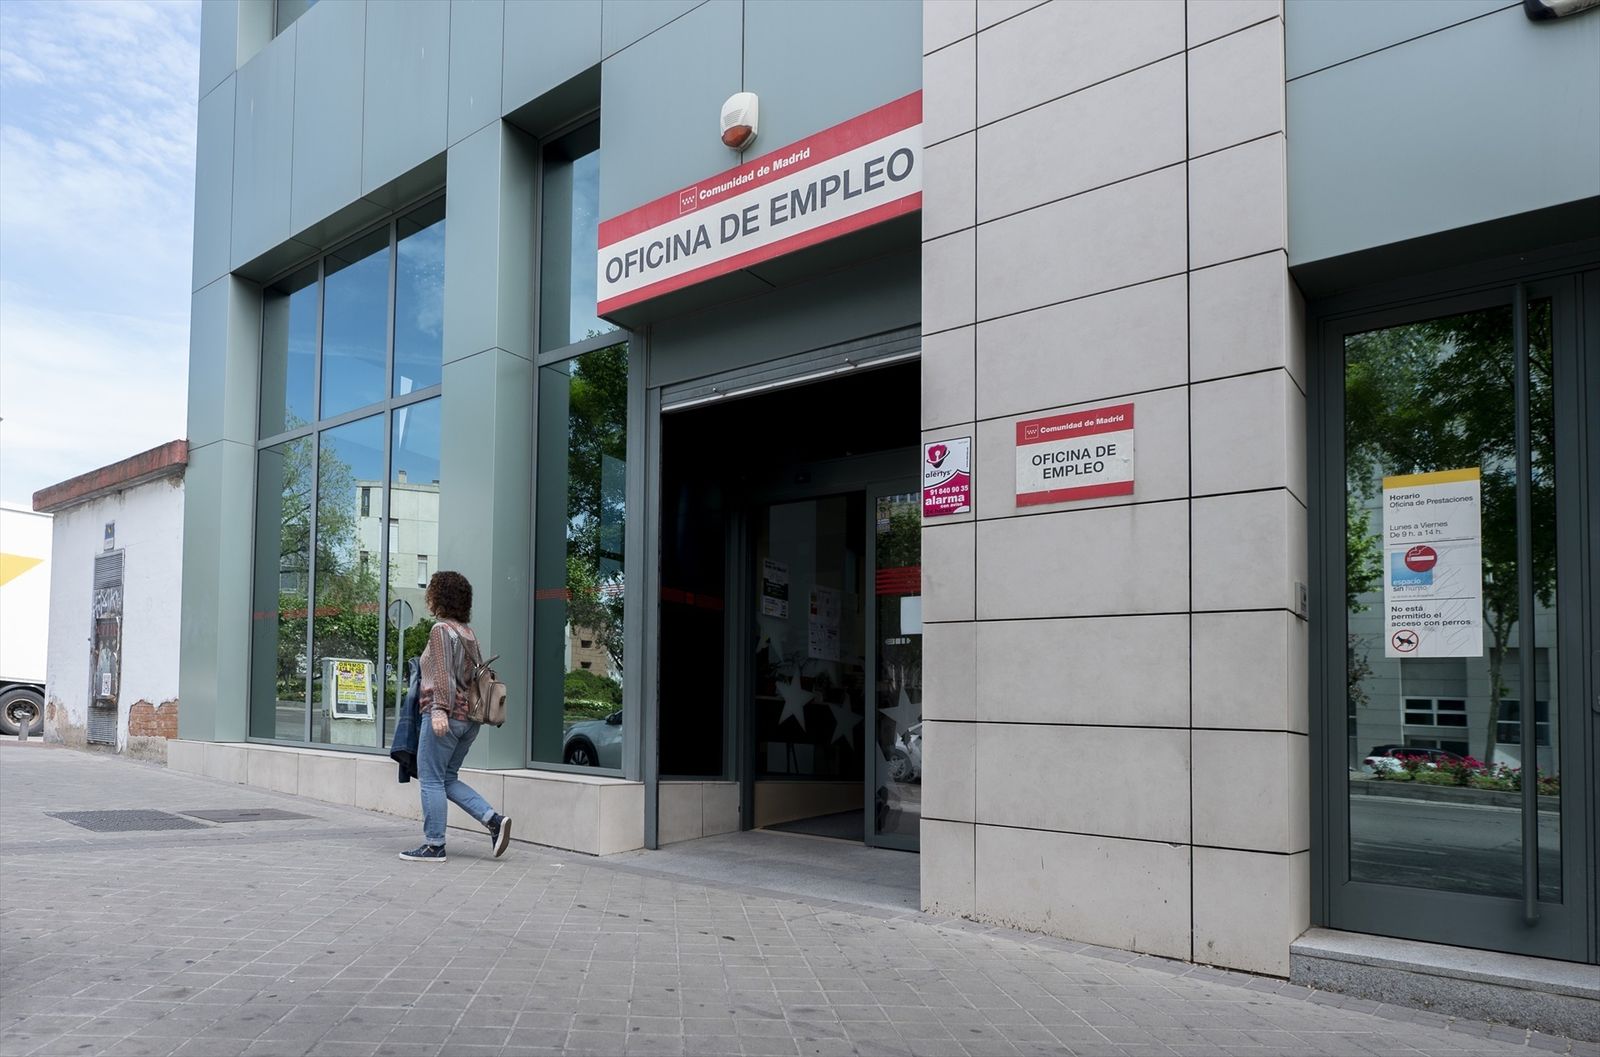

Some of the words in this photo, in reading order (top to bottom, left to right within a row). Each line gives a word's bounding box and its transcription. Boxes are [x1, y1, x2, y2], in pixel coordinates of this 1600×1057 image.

[699, 170, 754, 200] Comunidad
[756, 164, 770, 177] de
[772, 147, 810, 171] Madrid
[605, 224, 712, 283] OFICINA
[720, 203, 760, 244] DE
[770, 147, 914, 227] EMPLEO
[1040, 421, 1083, 434] Comunidad
[1084, 419, 1094, 427] de
[1096, 414, 1124, 426] Madrid
[1032, 448, 1091, 467] OFICINA
[1095, 443, 1117, 458] DE
[1042, 460, 1104, 480] EMPLEO
[938, 487, 950, 495] 840
[925, 495, 965, 506] alarma
[1389, 500, 1414, 508] Oficina
[1426, 496, 1474, 505] Prestaciones
[1390, 493, 1420, 501] Horario
[1420, 521, 1448, 529] Viernes
[1392, 578, 1421, 587] espacio
[1391, 612, 1432, 620] permitido
